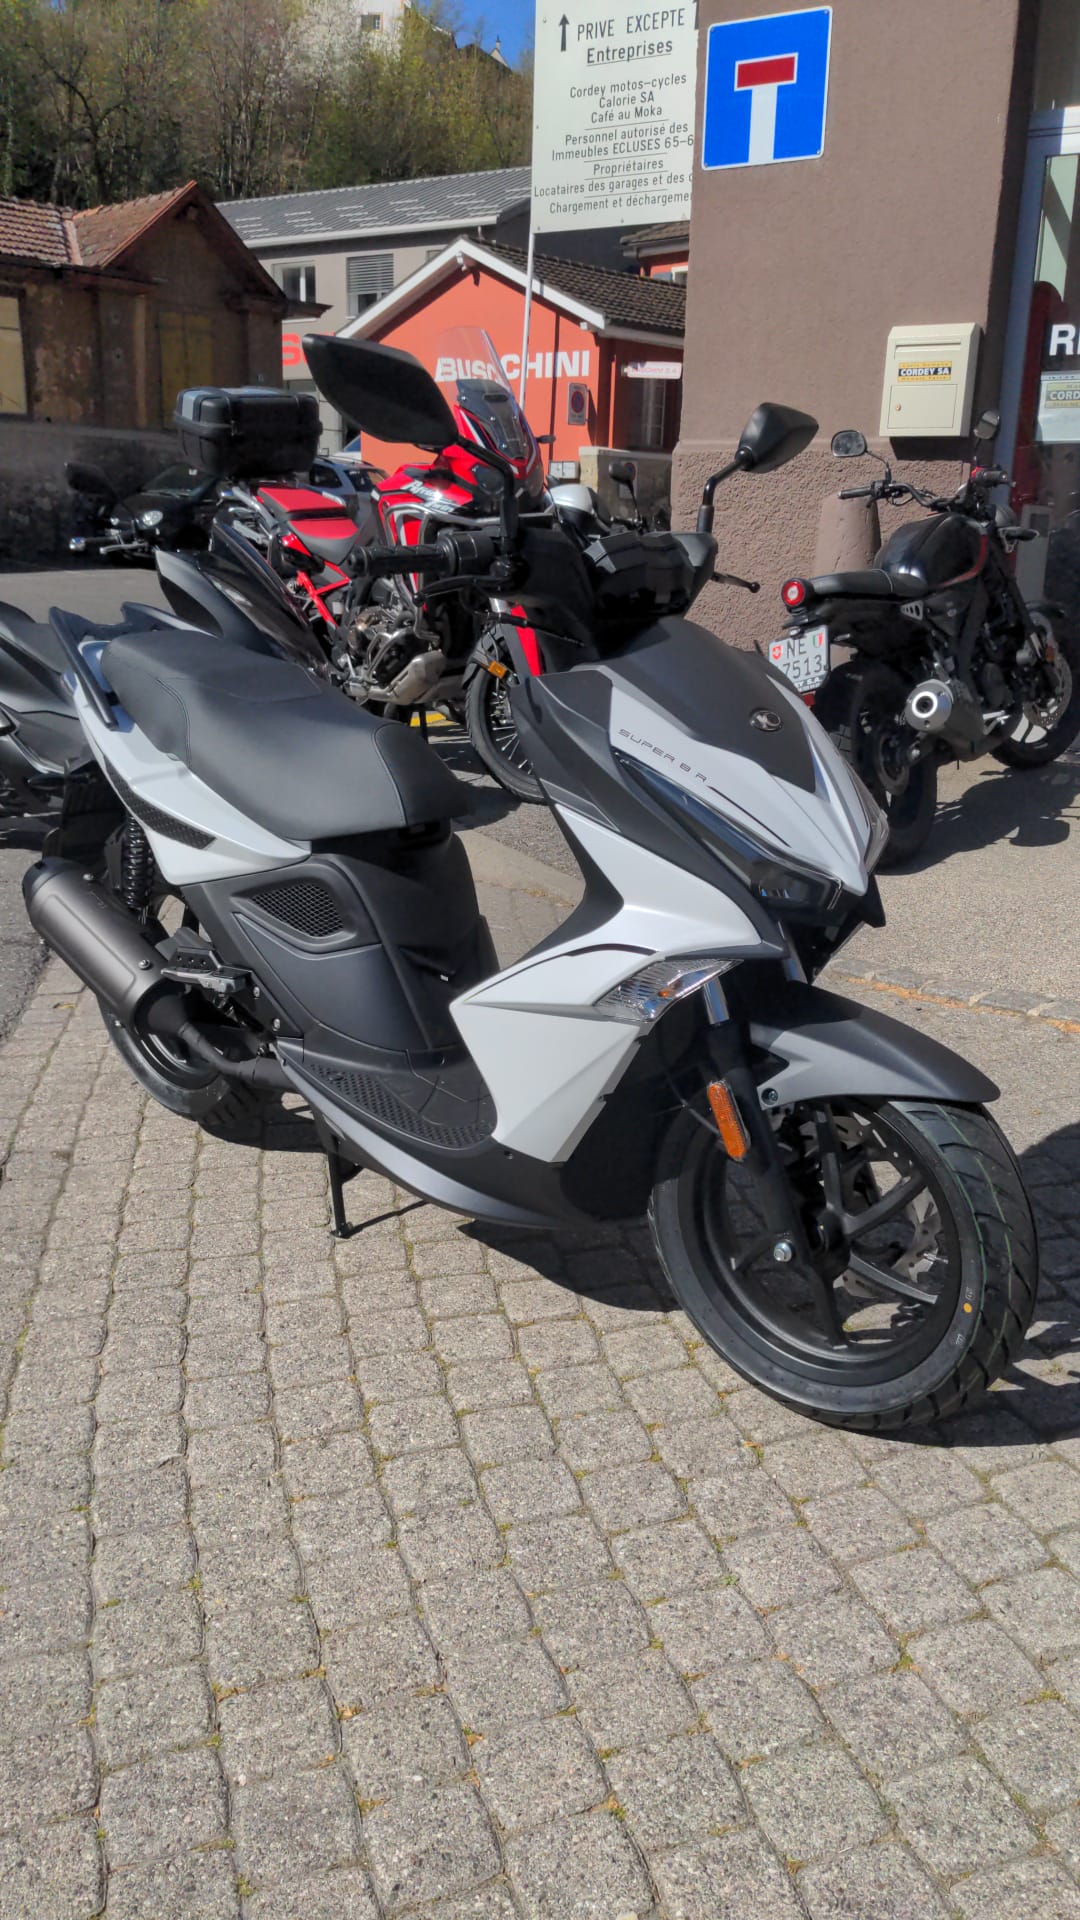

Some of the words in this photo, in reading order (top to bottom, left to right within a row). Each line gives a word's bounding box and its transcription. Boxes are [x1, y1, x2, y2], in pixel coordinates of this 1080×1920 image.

[577, 19, 615, 42] PRIVE
[626, 8, 686, 34] EXCEPTE
[587, 40, 673, 64] Entreprises
[570, 84, 606, 99] Cordey
[610, 73, 687, 93] motos-cycles
[599, 94, 637, 109] Calorie
[640, 91, 655, 103] SA
[591, 109, 614, 124] Café
[618, 110, 631, 120] au
[634, 105, 663, 118] Moka
[565, 129, 618, 146] Personnel
[621, 123, 666, 140] autorisé
[669, 122, 689, 135] des
[552, 145, 609, 161] Immeubles
[613, 138, 661, 155] ECLUSES
[593, 159, 664, 177] Propriétaires
[534, 182, 585, 198] Locataires
[588, 180, 606, 193] des
[608, 177, 649, 193] garages
[652, 174, 663, 186] et
[666, 172, 685, 184] des
[549, 198, 609, 215] Chargement
[612, 196, 623, 208] et
[626, 192, 692, 207] déchargeme
[900, 368, 936, 376] CORDEY
[937, 367, 950, 375] SA
[787, 638, 807, 659] NE
[783, 654, 822, 679] 7513
[618, 728, 676, 763] SUPER
